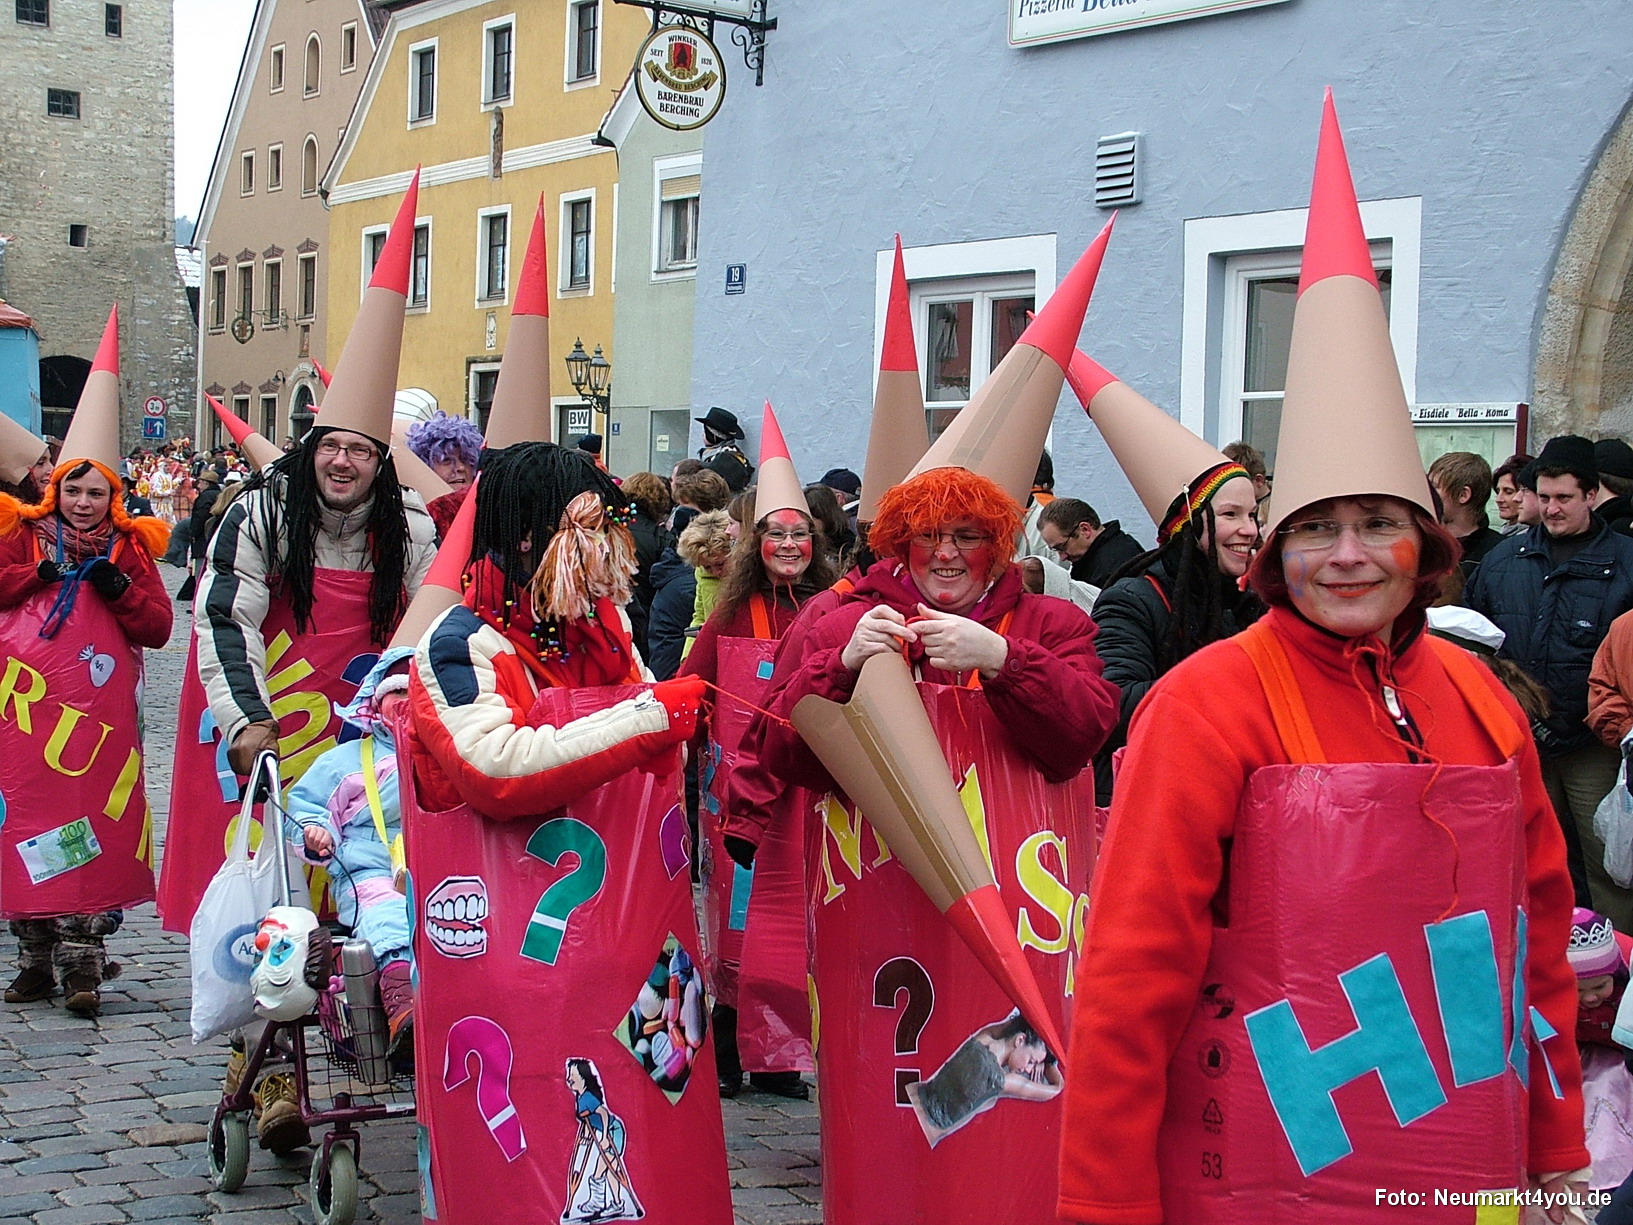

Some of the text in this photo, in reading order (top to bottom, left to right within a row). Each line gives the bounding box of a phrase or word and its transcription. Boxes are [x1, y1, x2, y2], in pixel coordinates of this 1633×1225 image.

[668, 35, 698, 47] WINKLER
[650, 48, 664, 57] SEIT
[659, 102, 700, 118] BERCHING
[731, 266, 740, 282] 19
[569, 411, 588, 425] BW
[1419, 408, 1449, 418] Eisdiele
[60, 820, 87, 840] 100
[519, 816, 607, 966] ?
[872, 956, 935, 1107] ?
[443, 1015, 527, 1162] ?
[1202, 1152, 1223, 1180] 53
